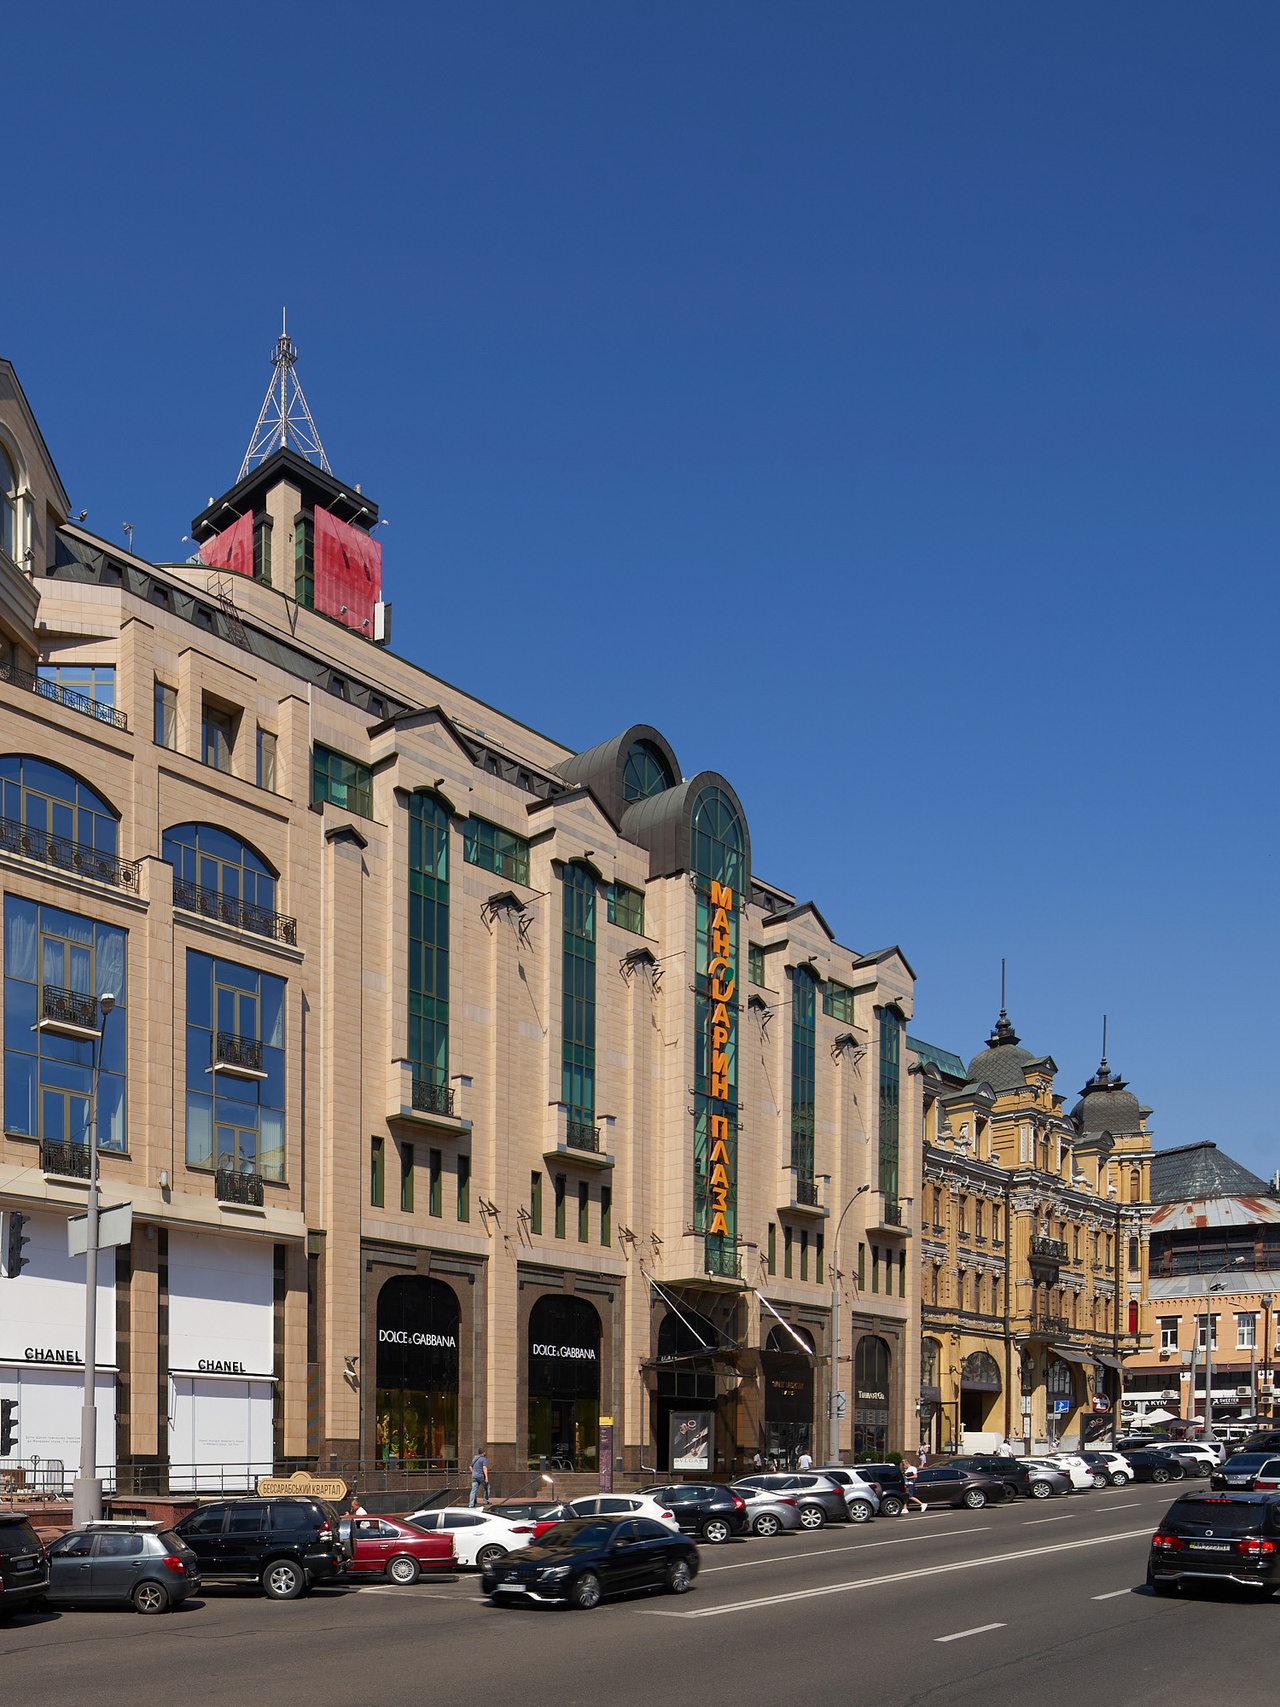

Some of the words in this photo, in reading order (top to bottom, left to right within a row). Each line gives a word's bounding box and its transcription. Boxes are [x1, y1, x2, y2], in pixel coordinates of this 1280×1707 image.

[710, 1115, 729, 1237] ПЛАЗА
[24, 1347, 83, 1362] CHANEL
[198, 1359, 246, 1373] CHANEL
[263, 1482, 311, 1494] БЕССАРАБСЬКИЙ
[312, 1484, 341, 1495] КВАРТАЛ
